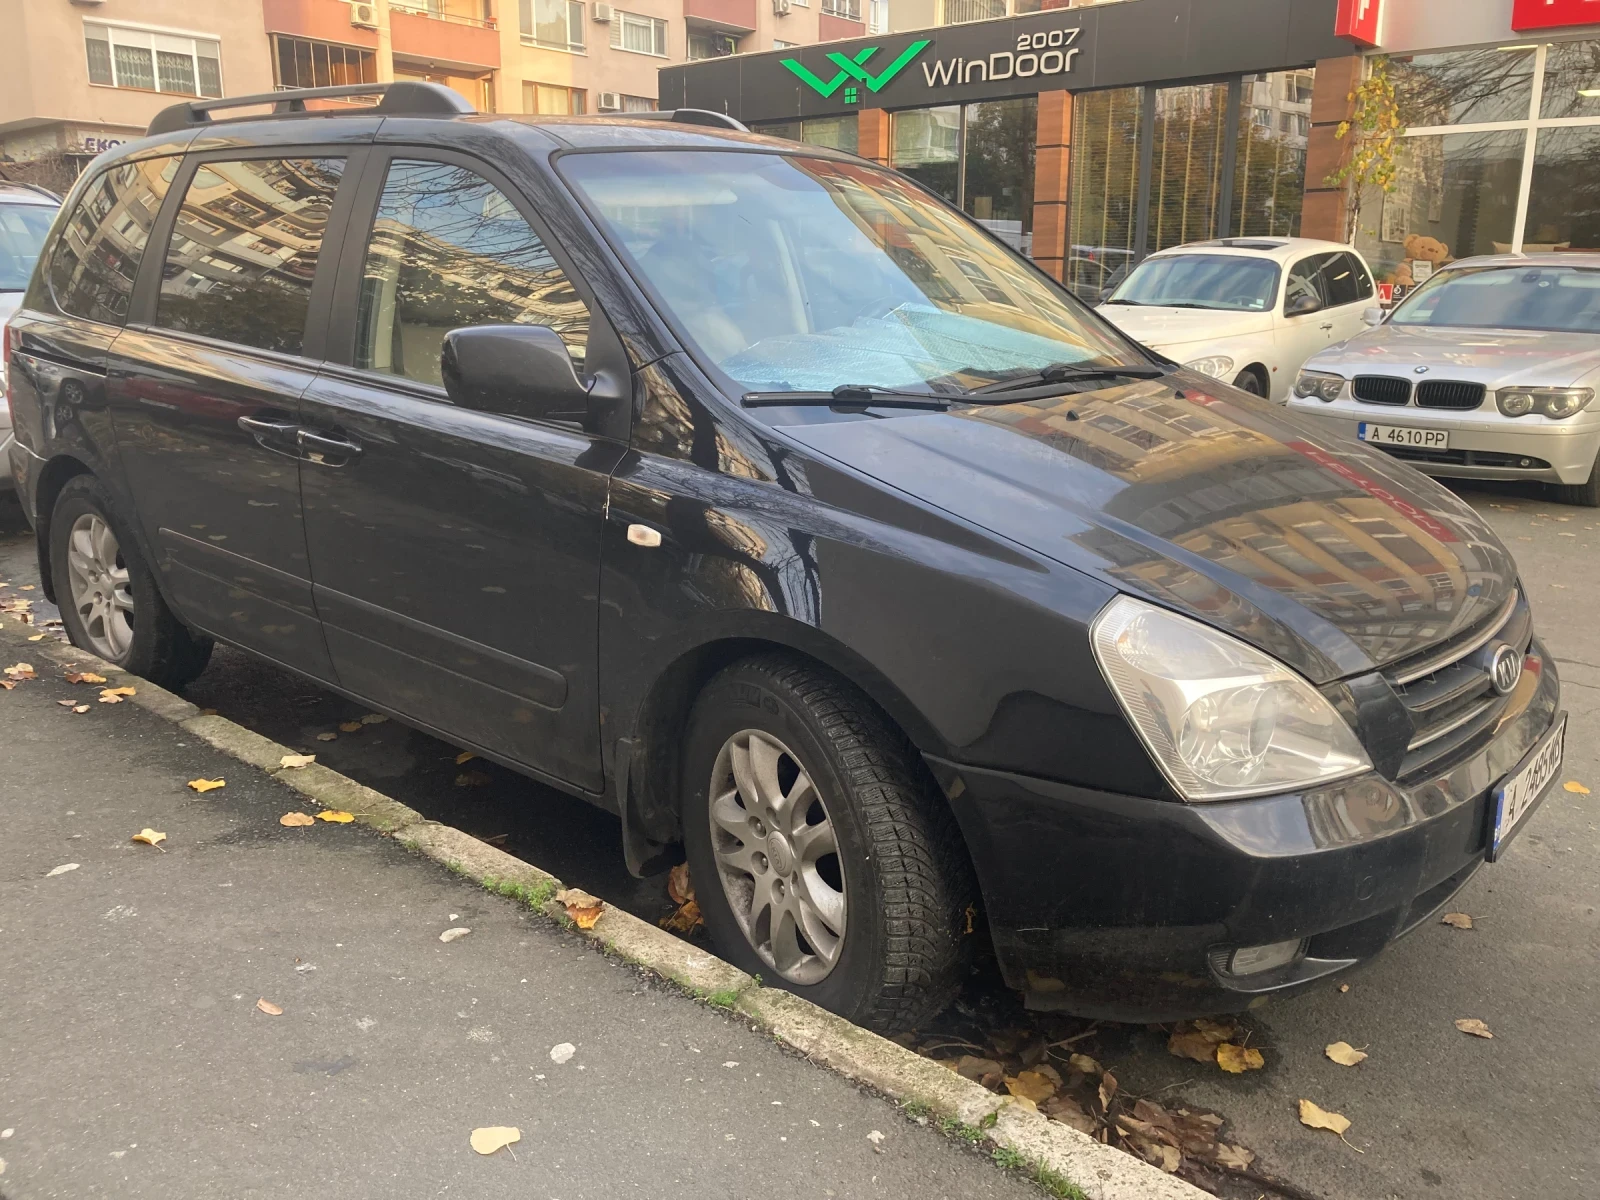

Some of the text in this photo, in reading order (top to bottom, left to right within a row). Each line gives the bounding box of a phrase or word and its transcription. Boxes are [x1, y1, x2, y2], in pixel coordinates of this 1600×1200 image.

[1017, 28, 1080, 50] 2007
[922, 48, 1079, 87] WinDoor
[1371, 426, 1380, 441] A
